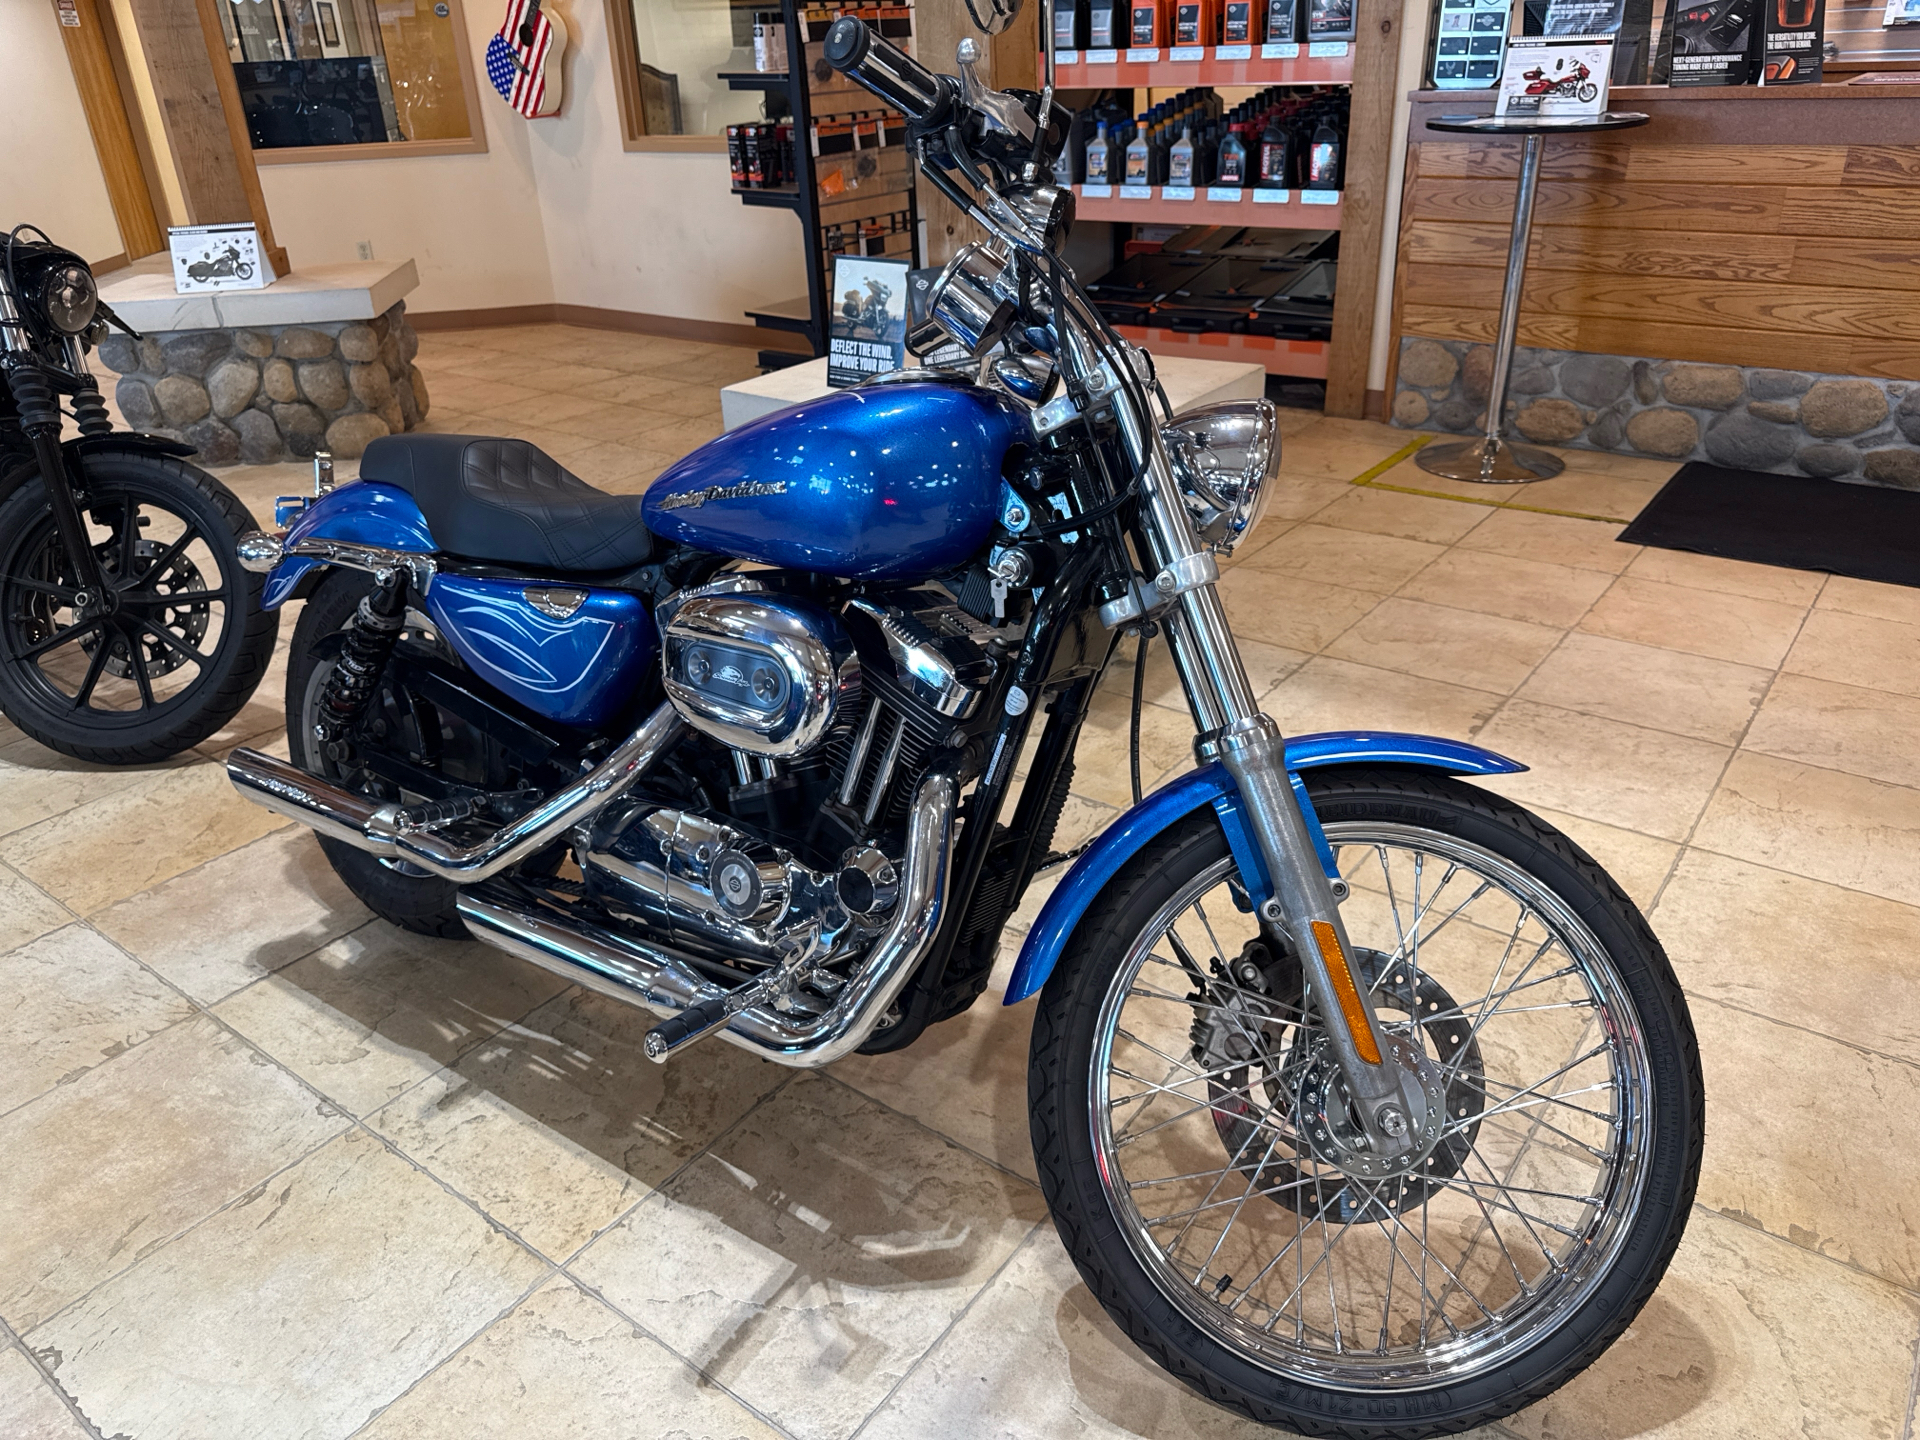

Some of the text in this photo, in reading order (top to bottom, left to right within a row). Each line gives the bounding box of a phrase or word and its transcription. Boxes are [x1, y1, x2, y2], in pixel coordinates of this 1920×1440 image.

[1673, 55, 1711, 63] NEXT-GENERATION
[830, 338, 893, 360] DEFLECT THE WIND.
[934, 350, 960, 364] LEGENDARY
[829, 352, 859, 370] IMPROVE
[859, 356, 878, 372] YOUR
